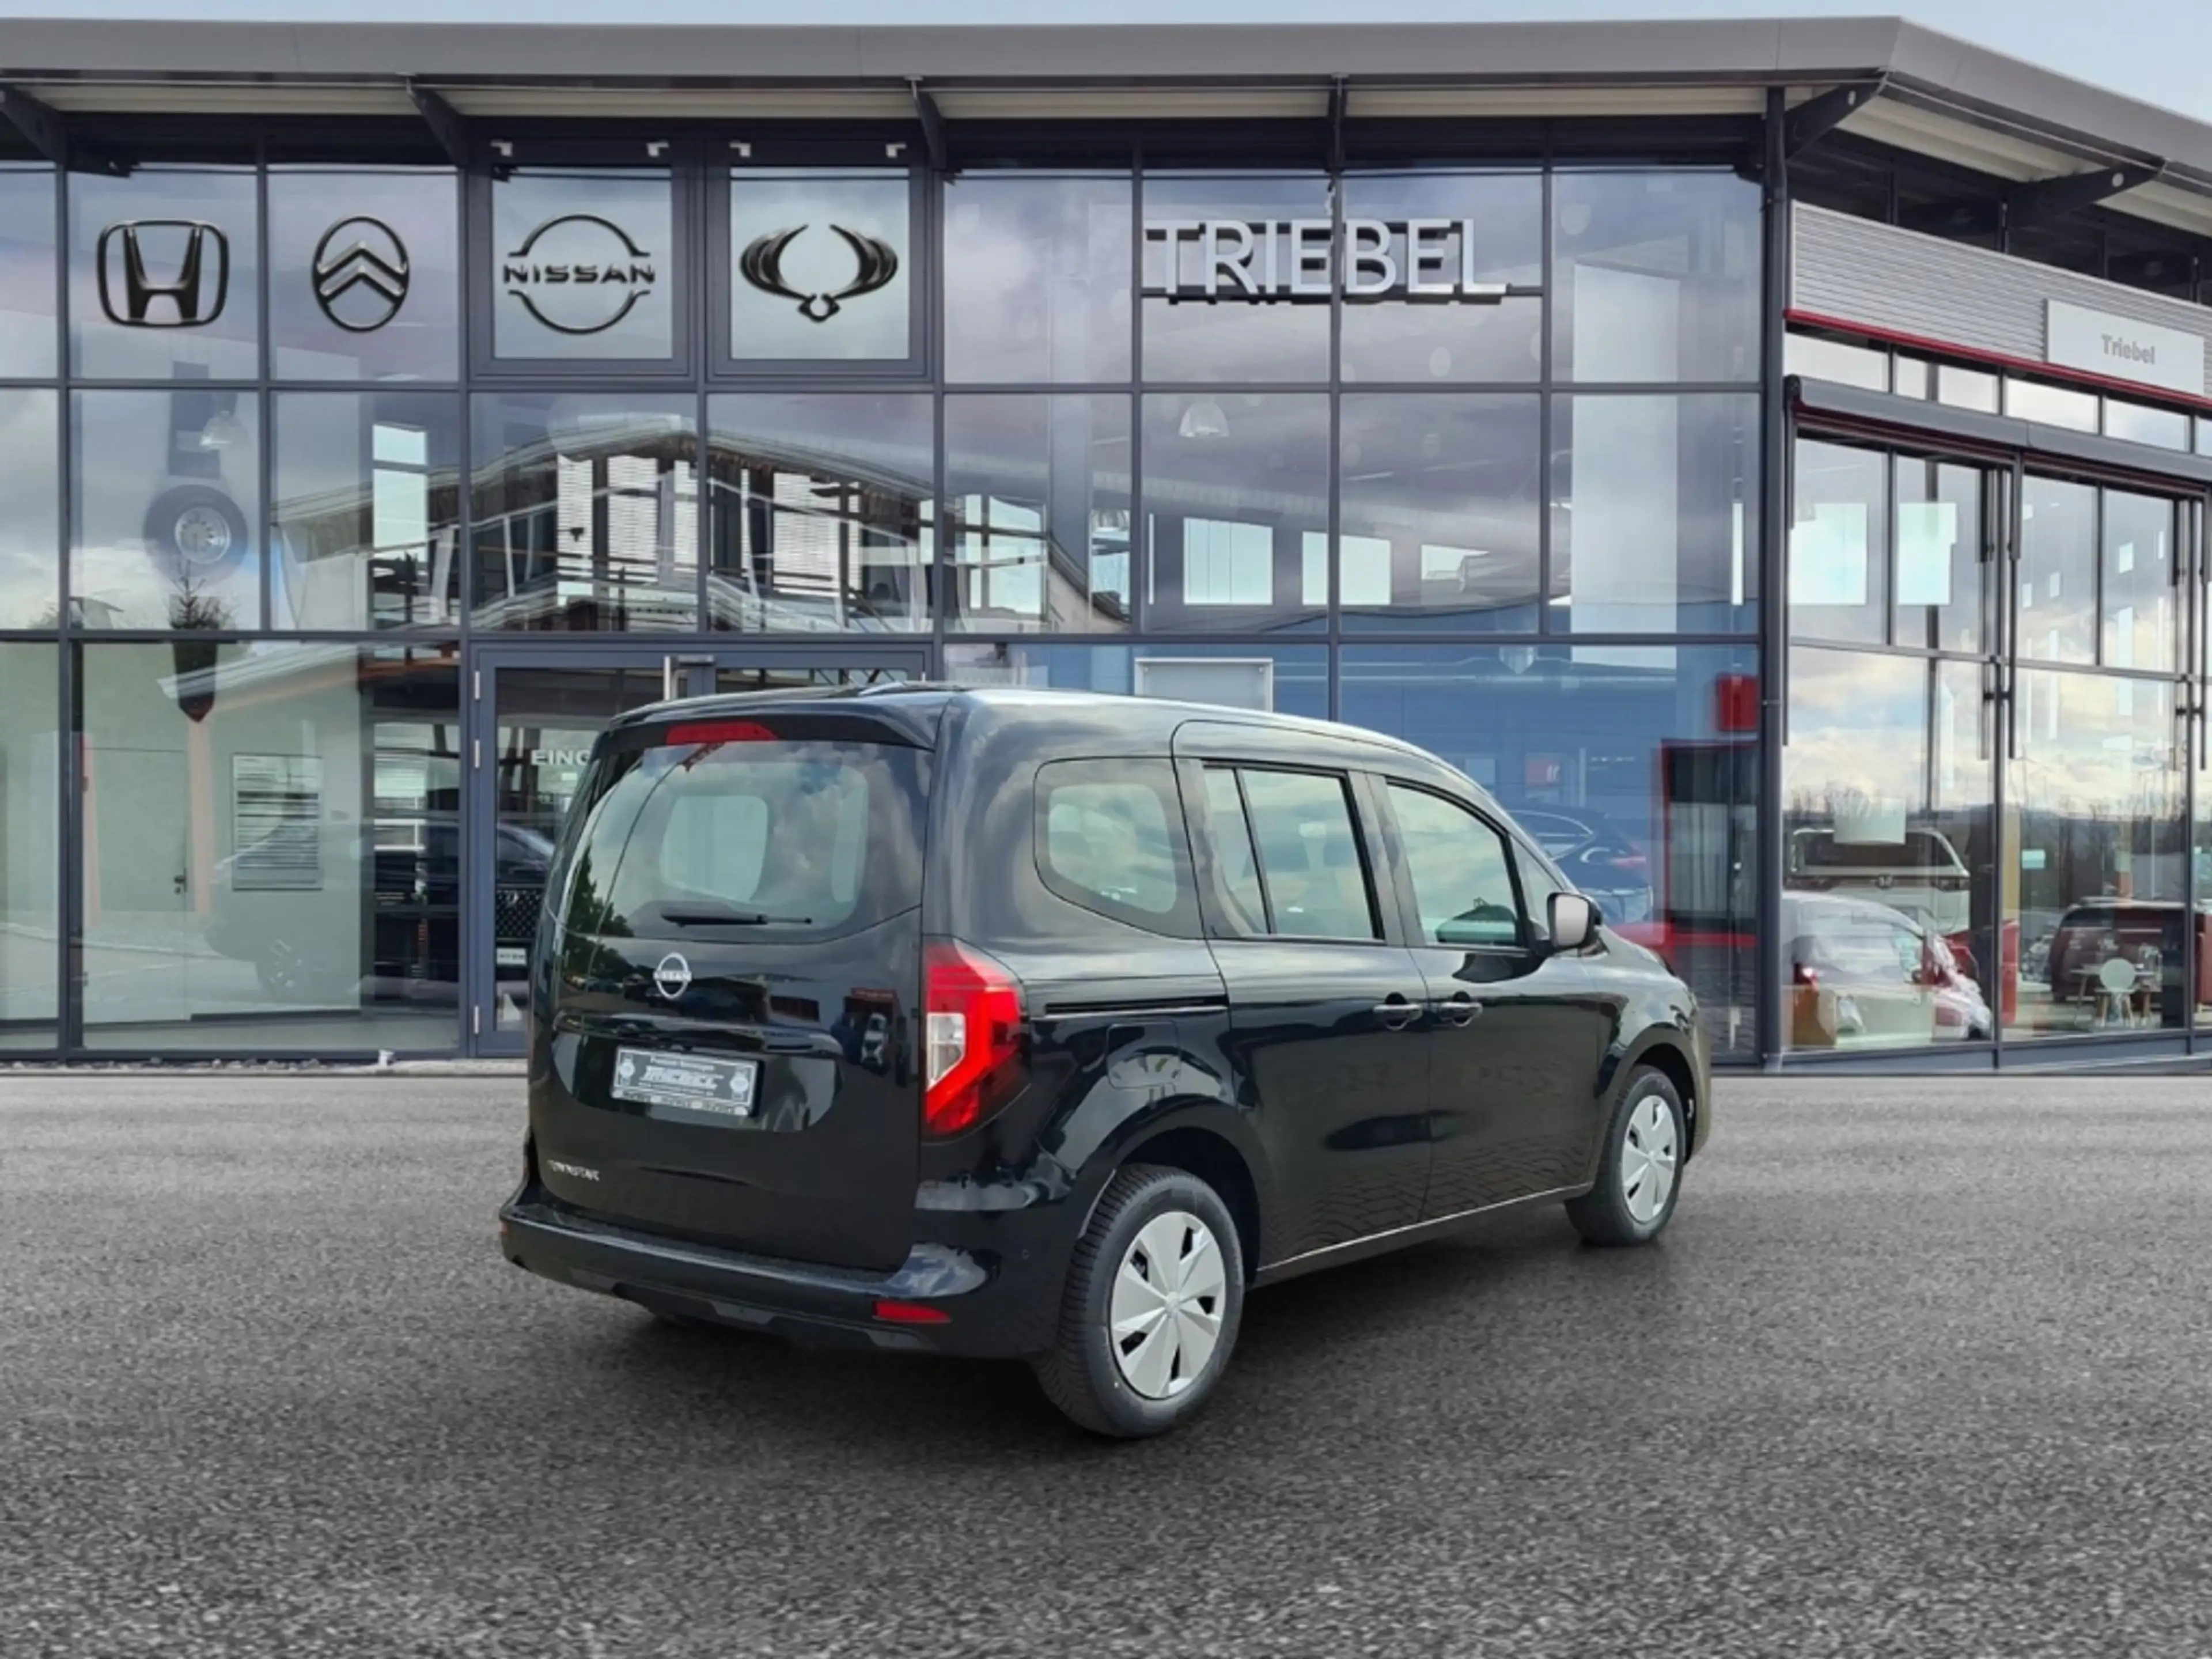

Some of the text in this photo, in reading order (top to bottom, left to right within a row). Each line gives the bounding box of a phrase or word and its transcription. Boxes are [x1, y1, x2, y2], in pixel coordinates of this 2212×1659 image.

[1144, 218, 1507, 295] TRIEBEL
[503, 264, 656, 284] NISSAN
[2101, 332, 2156, 365] Triebel
